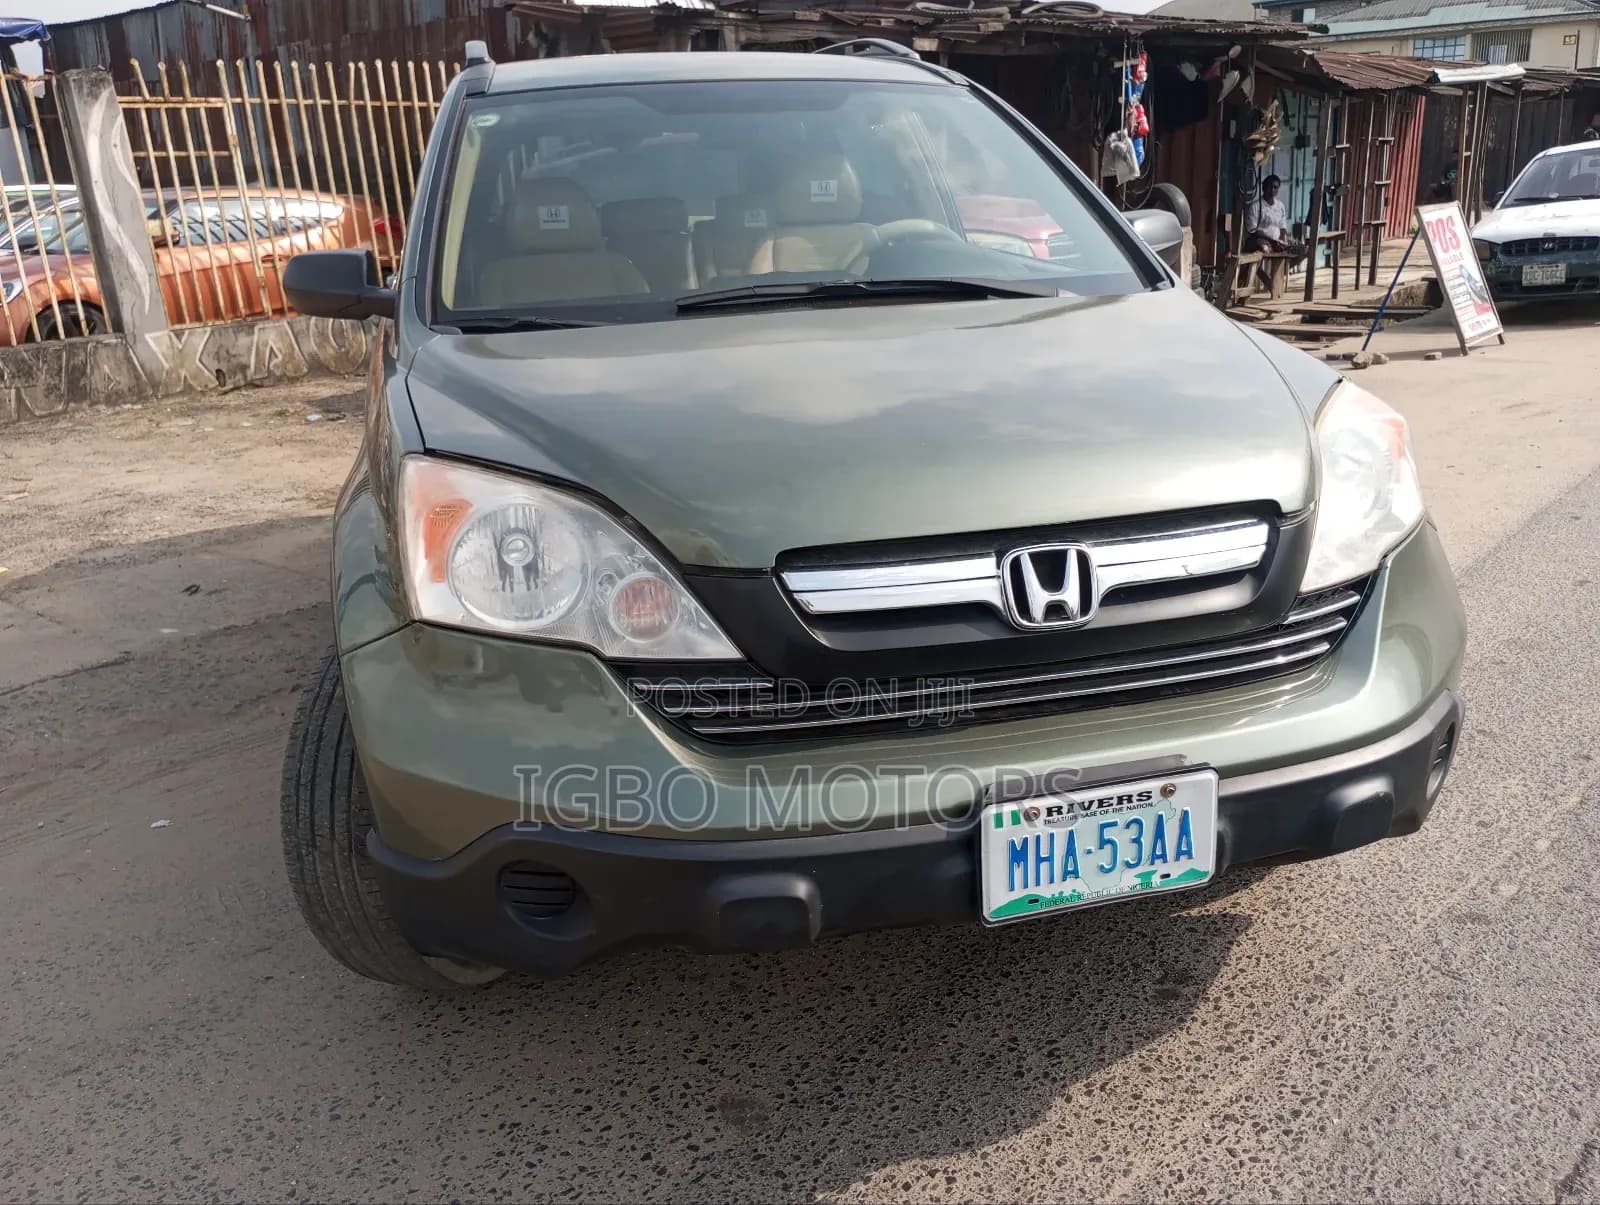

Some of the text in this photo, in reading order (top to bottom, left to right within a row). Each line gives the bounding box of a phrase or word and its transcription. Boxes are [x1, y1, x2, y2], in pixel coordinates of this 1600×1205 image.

[1425, 215, 1460, 253] POS
[1045, 790, 1153, 817] RIVERS
[1099, 808, 1110, 817] OF
[1040, 895, 1075, 909] FEDERAL
